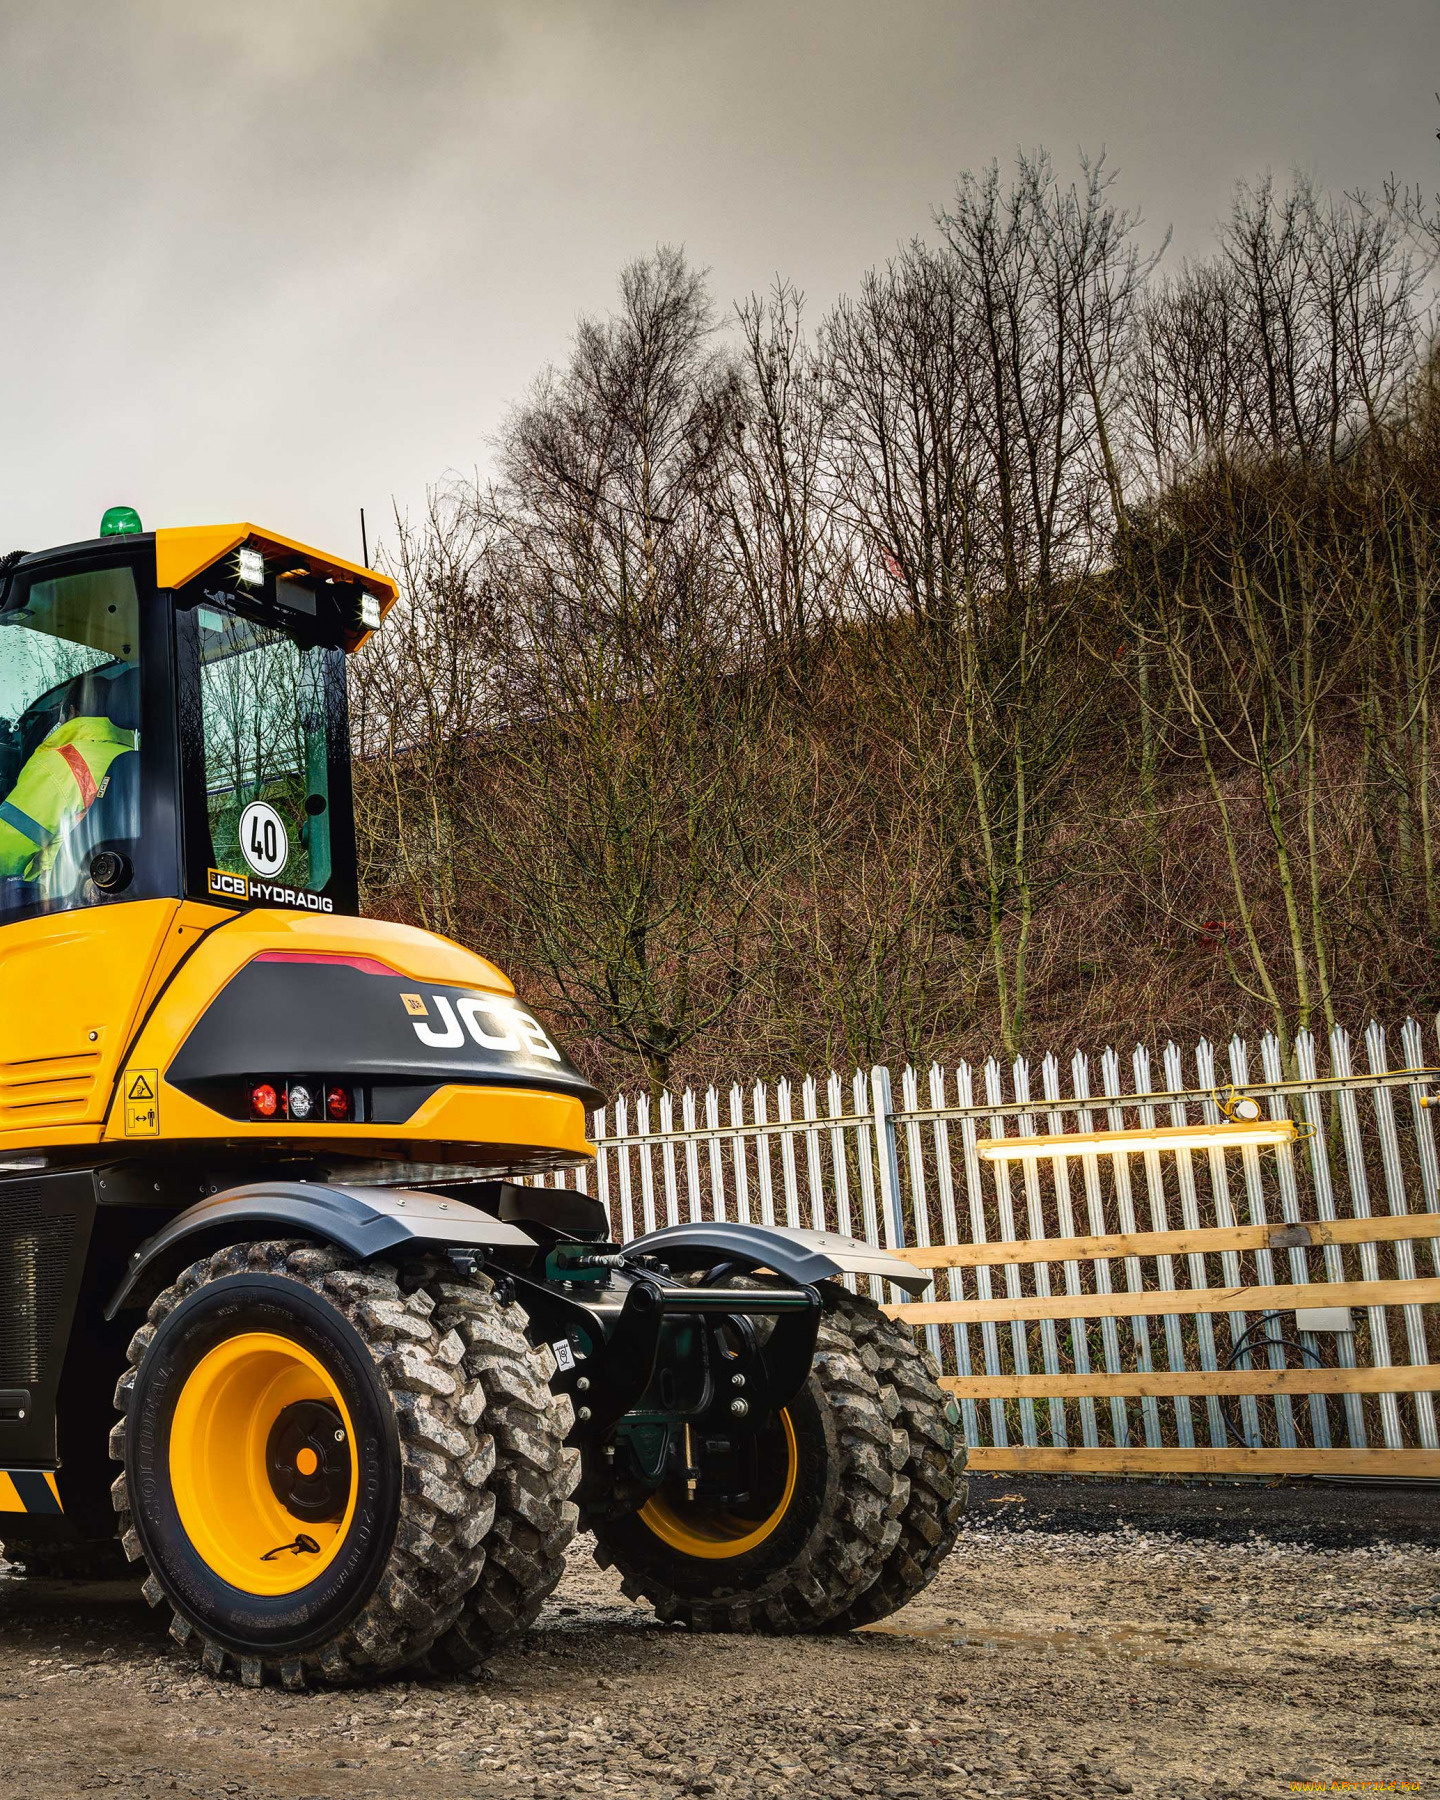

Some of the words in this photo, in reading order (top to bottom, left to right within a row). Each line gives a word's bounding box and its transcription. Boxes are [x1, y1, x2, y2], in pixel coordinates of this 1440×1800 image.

[250, 815, 277, 863] 40
[211, 874, 246, 895] JCB
[249, 881, 333, 912] HYDRADIG
[412, 995, 561, 1062] JCB
